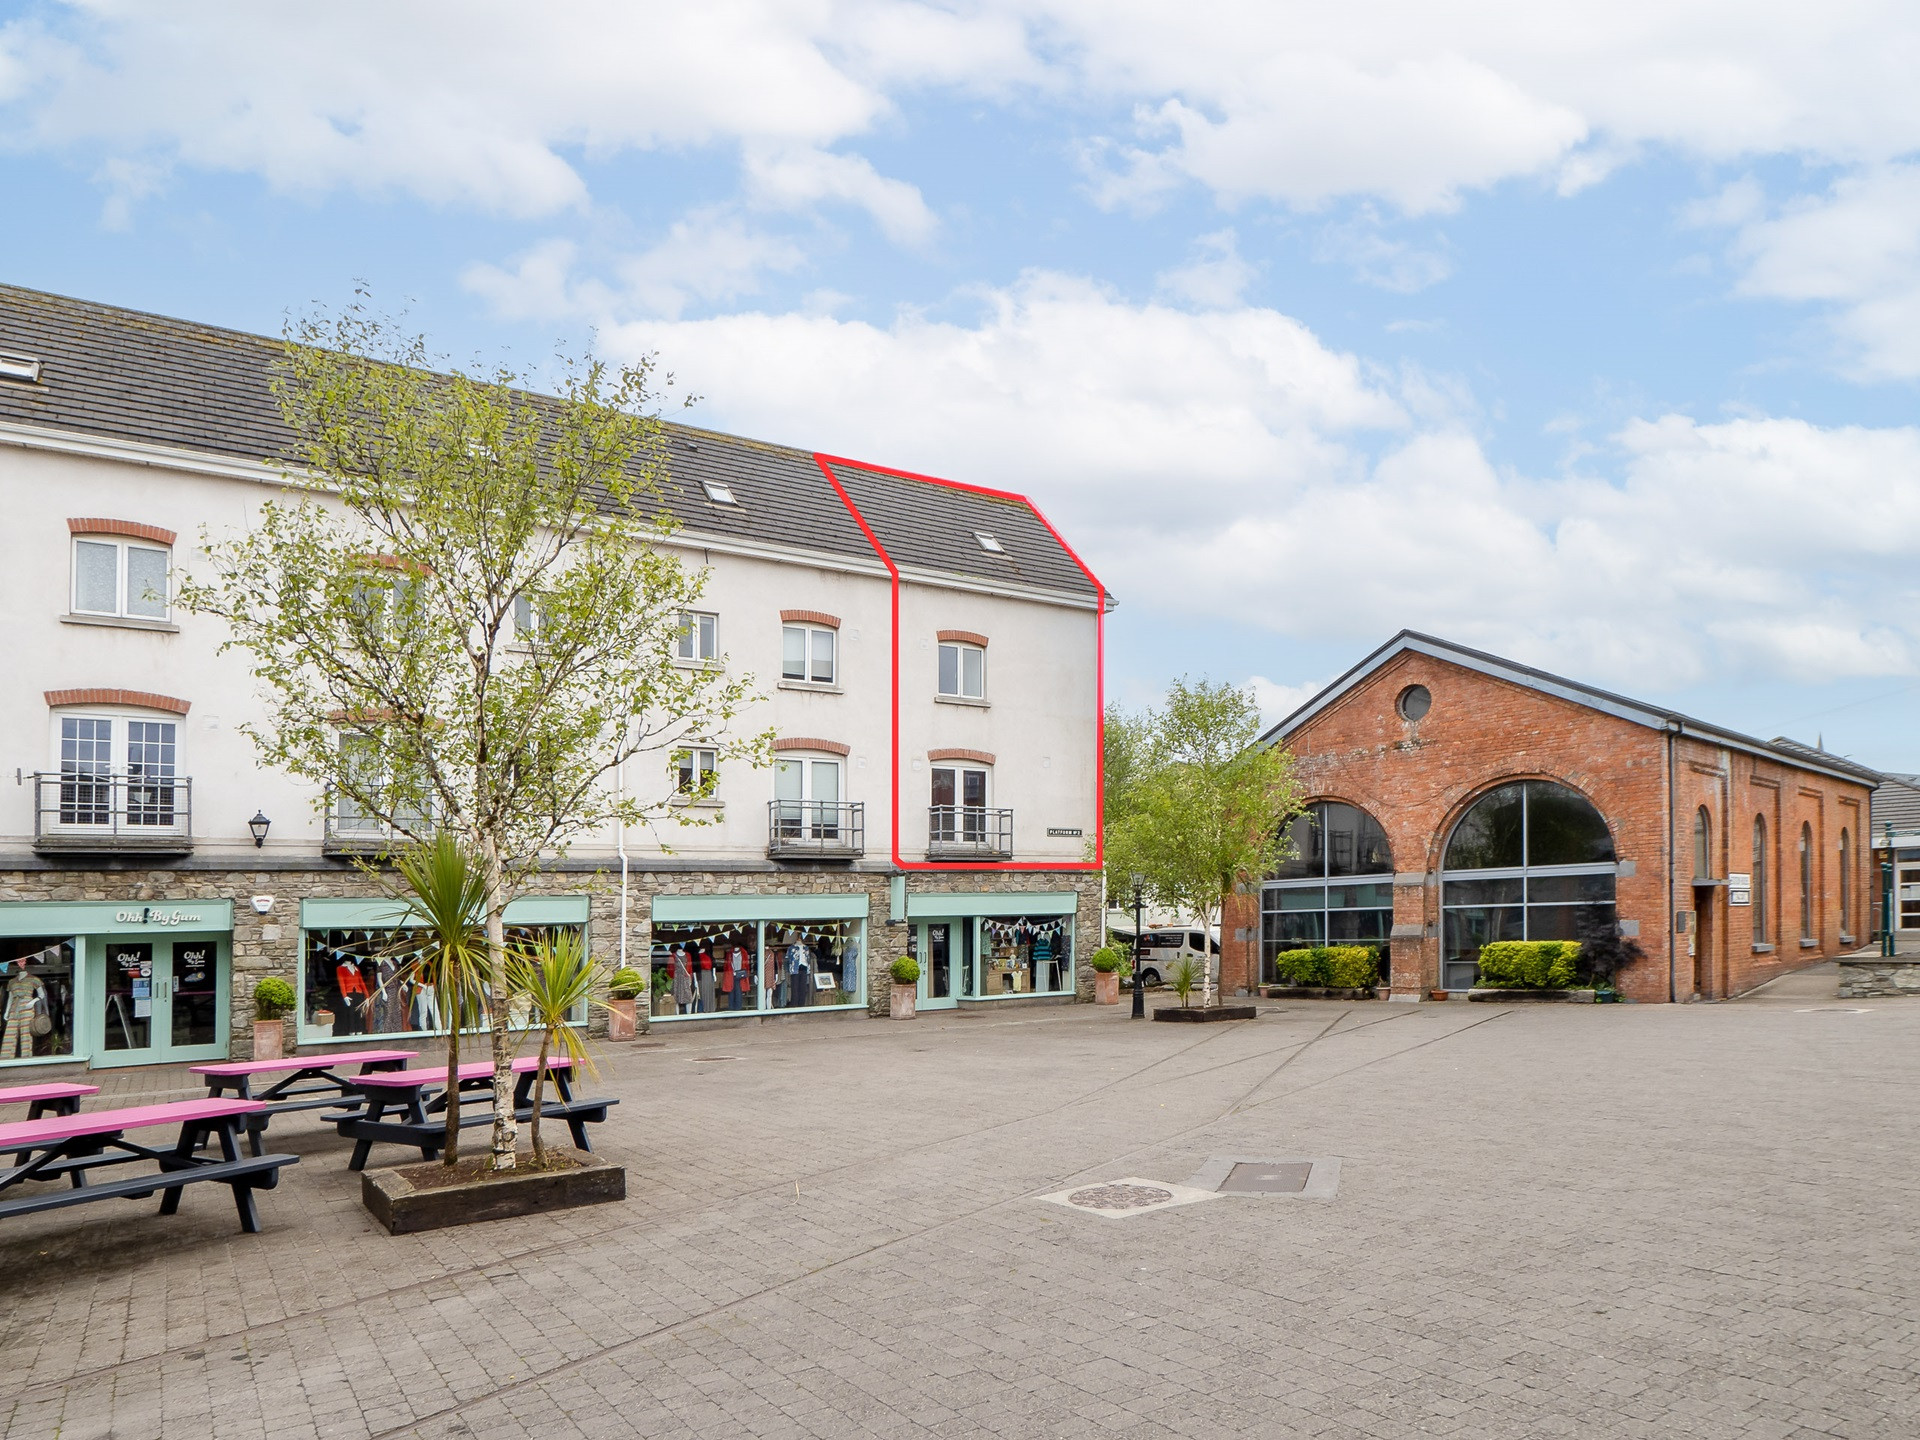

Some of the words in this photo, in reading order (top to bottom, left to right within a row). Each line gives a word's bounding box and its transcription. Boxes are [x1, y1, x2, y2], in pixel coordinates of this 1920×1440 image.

[115, 907, 150, 924] Ohh!
[149, 909, 170, 926] By
[170, 909, 201, 926] Gum
